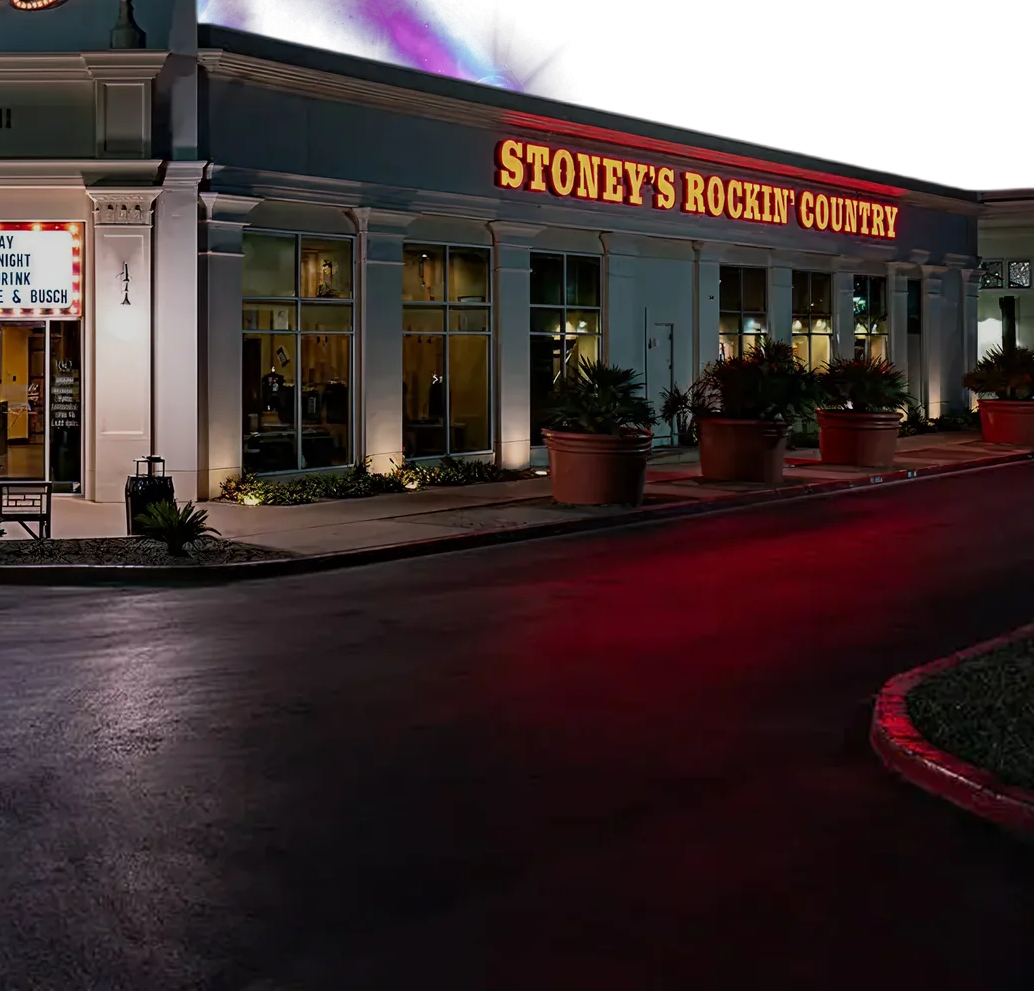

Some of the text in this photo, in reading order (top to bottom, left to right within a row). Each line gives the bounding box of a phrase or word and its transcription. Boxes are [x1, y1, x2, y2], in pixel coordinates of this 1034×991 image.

[498, 138, 900, 239] STONEY'S ROCKIN' COUNTRY
[11, 289, 22, 304] &
[30, 289, 68, 304] BUSCH
